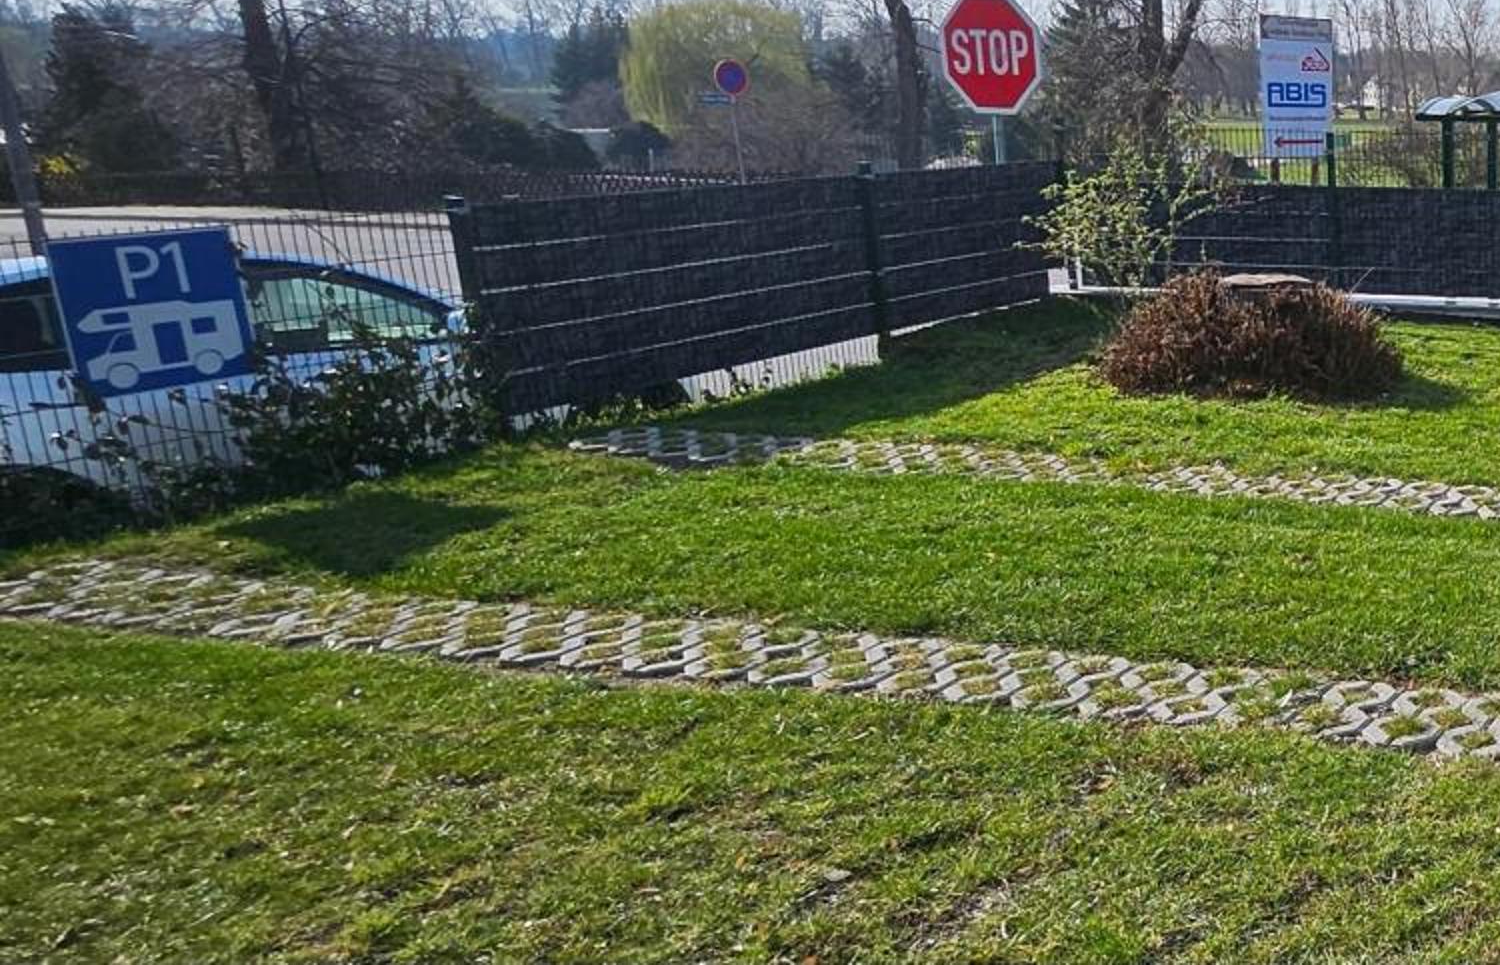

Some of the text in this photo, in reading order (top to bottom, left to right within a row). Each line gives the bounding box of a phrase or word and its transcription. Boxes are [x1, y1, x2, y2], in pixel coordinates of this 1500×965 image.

[951, 28, 1029, 76] STOP
[1267, 82, 1327, 107] ABIS
[115, 241, 191, 300] P1
